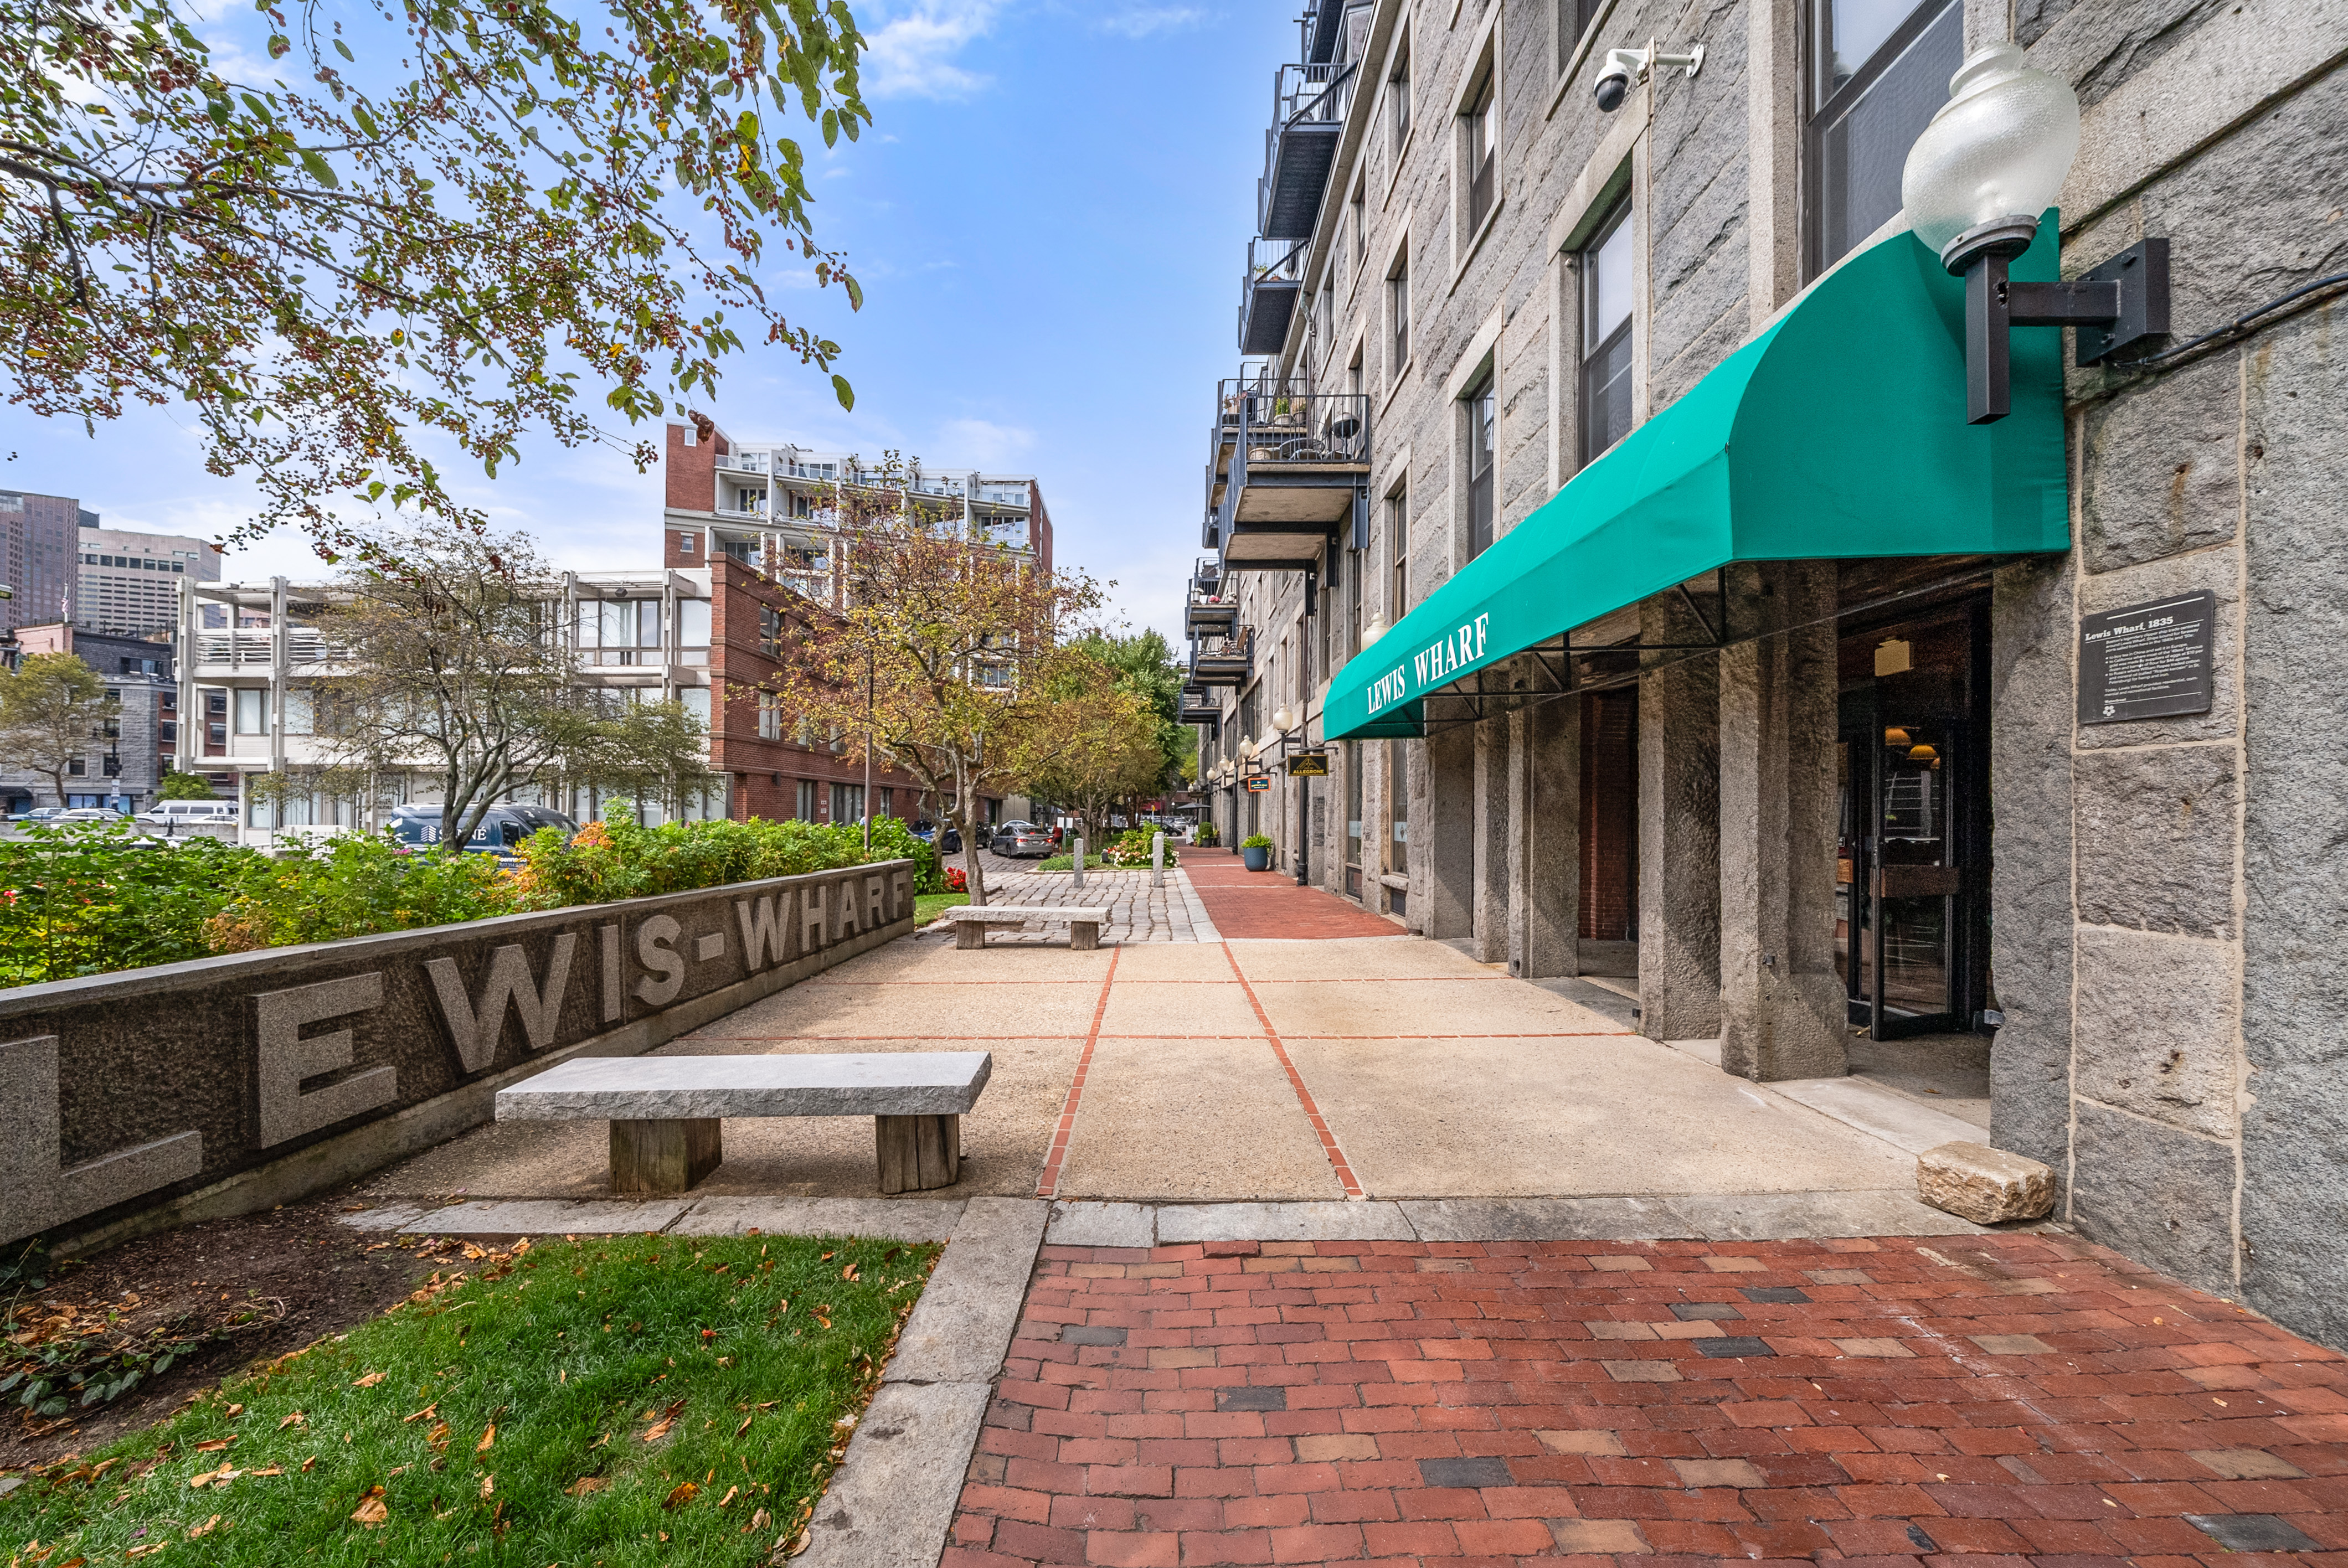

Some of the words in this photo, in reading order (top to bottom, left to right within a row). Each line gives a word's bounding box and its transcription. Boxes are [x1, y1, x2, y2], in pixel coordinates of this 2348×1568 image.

[2085, 630, 2110, 641] Lewis
[2114, 623, 2146, 635] Wharf,
[2149, 616, 2173, 628] 1835
[1367, 664, 1405, 714] LEWIS
[1414, 612, 1489, 688] WHARF
